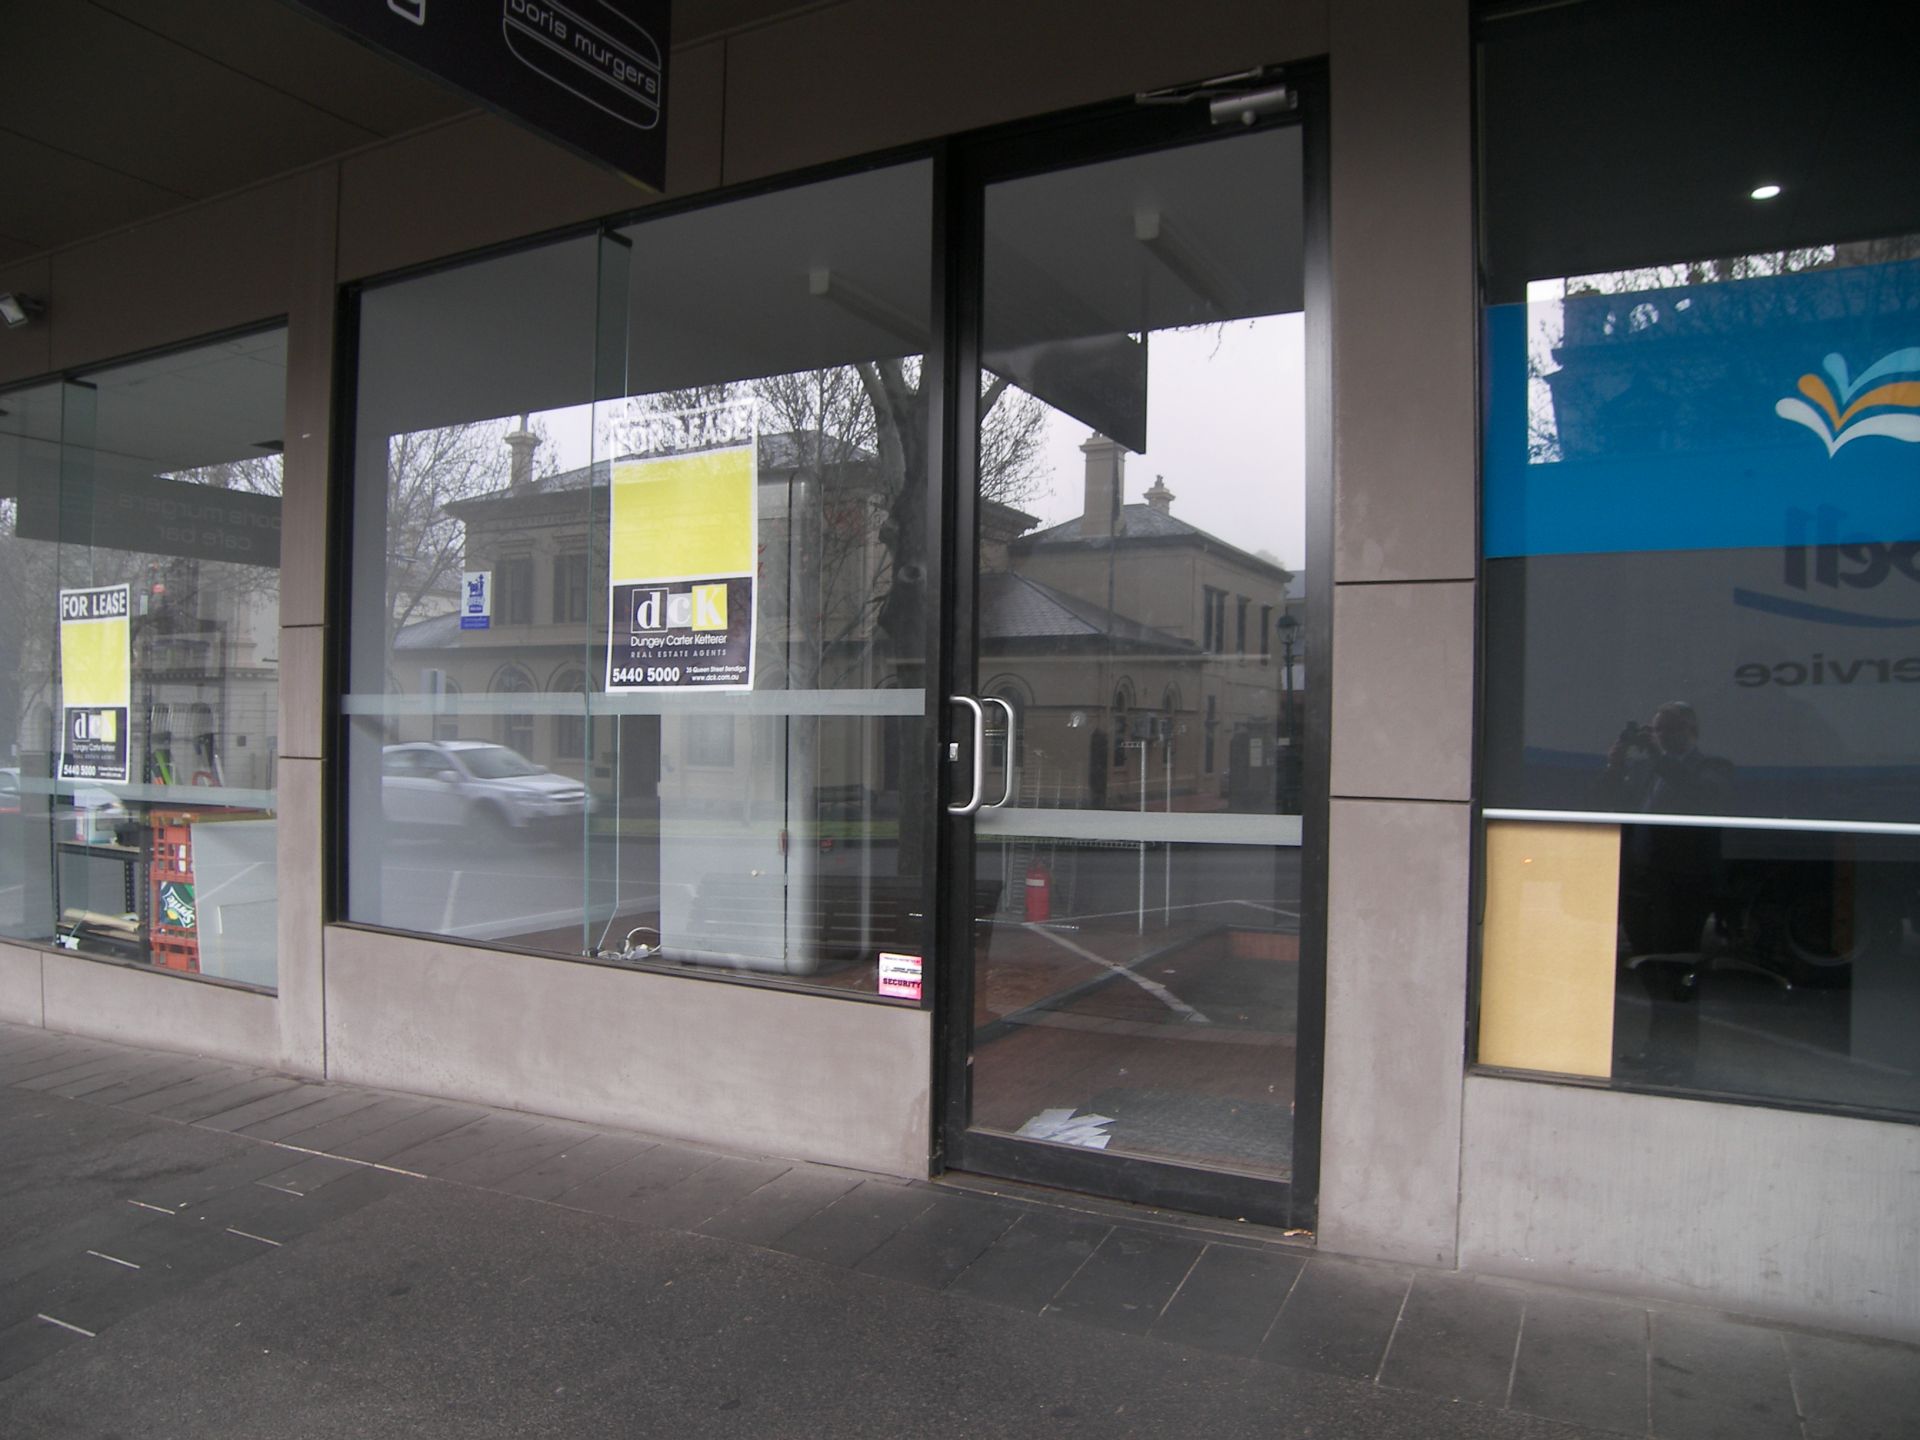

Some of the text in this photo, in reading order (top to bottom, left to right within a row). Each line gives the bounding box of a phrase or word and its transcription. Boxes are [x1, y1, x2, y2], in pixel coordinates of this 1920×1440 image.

[574, 33, 657, 94] murgers
[63, 591, 126, 617] FOR LEASE
[631, 634, 727, 648] Dungey Carter Ketterer
[658, 650, 688, 658] ESTATE
[612, 666, 680, 683] 5440 5000
[883, 977, 922, 989] SECURITY
